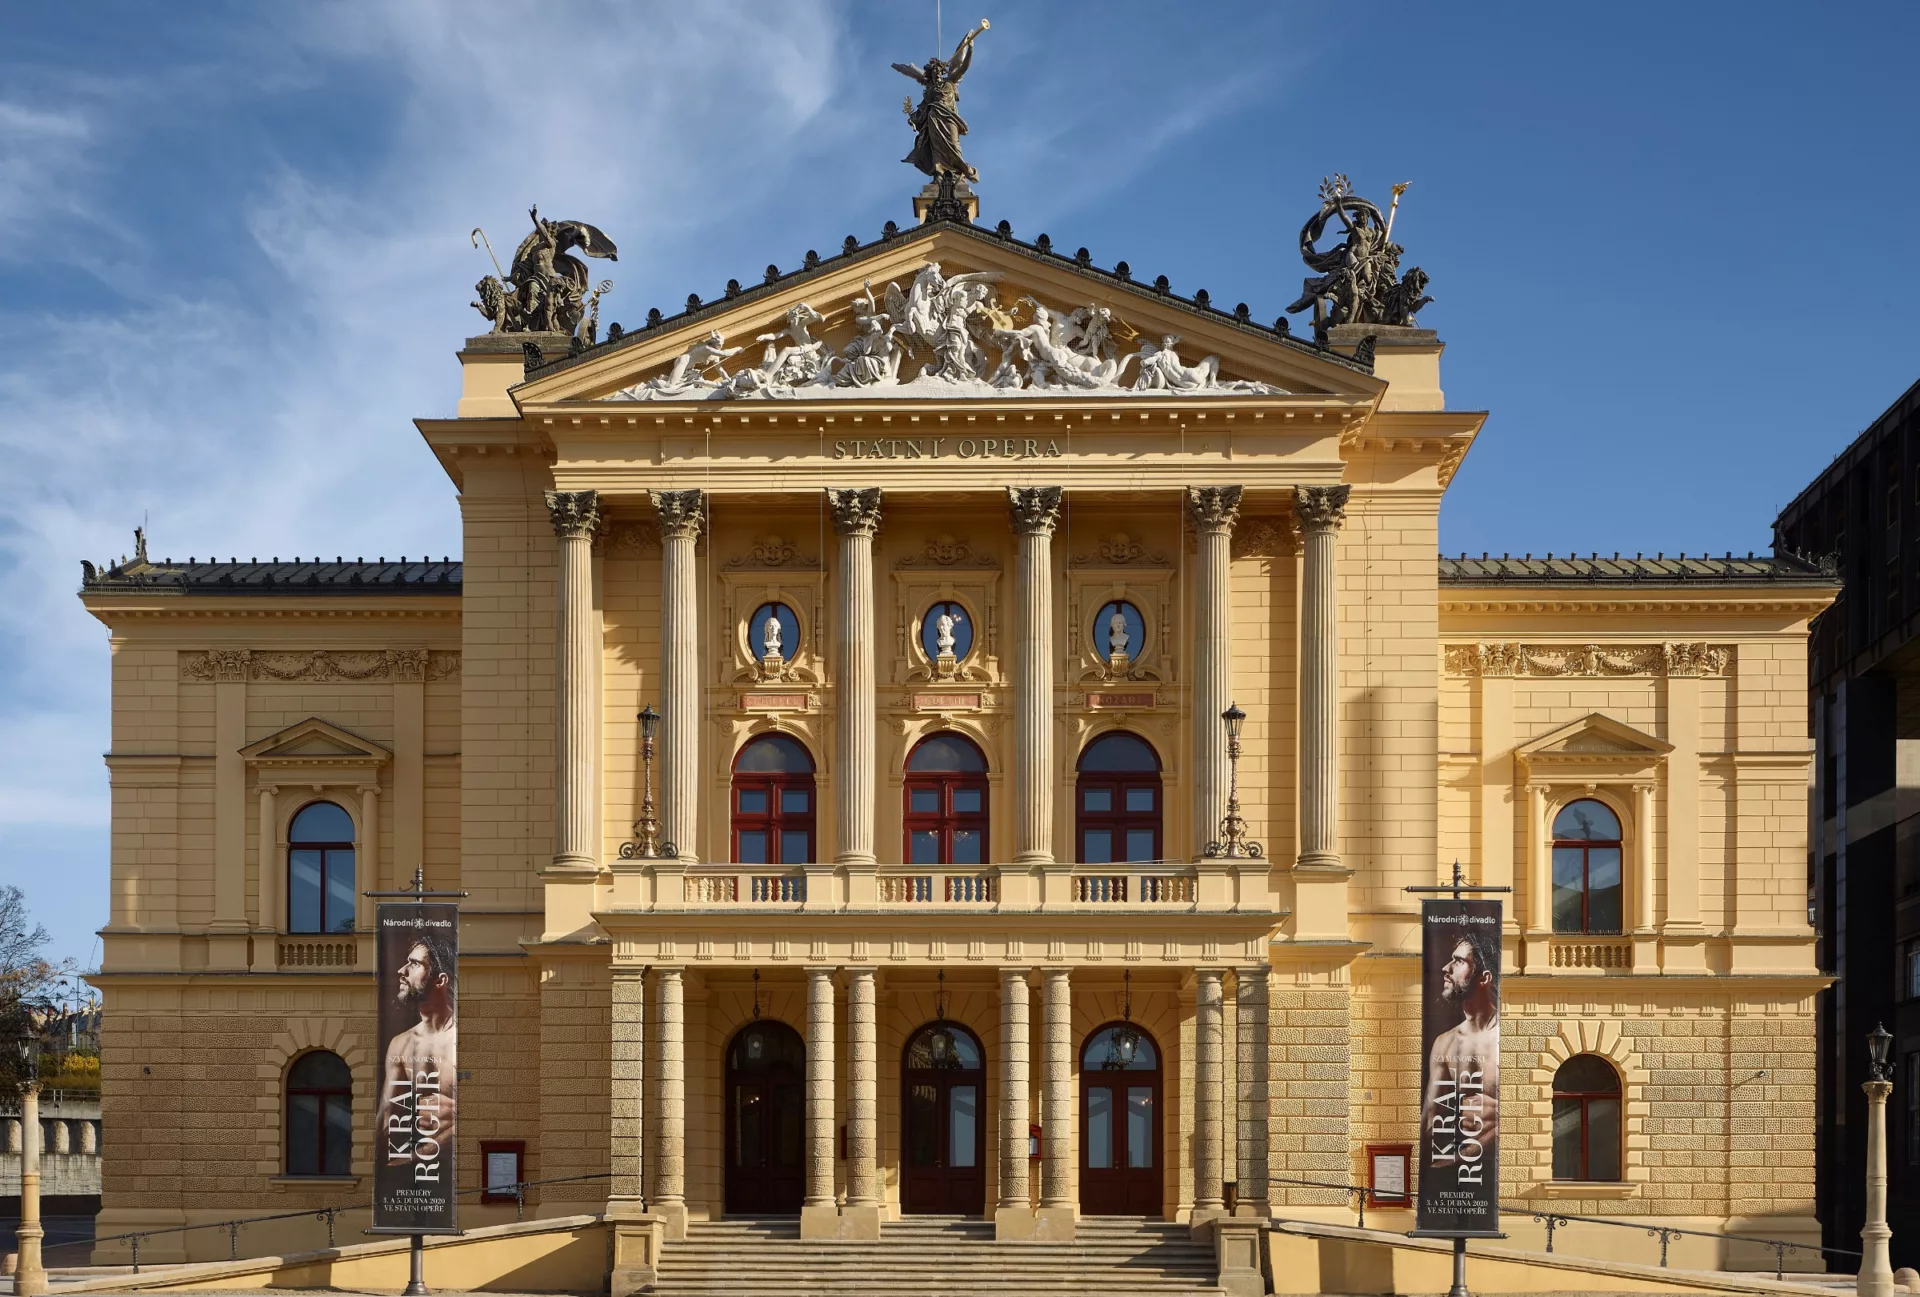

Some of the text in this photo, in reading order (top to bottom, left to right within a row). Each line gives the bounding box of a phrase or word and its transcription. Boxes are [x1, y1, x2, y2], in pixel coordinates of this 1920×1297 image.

[834, 437, 1062, 459] STÁTNÍ OPERA
[383, 918, 452, 927] Národní divadlo
[387, 1056, 443, 1064] SZYMANOWSKI
[1432, 1055, 1485, 1063] SZYMANOWSKI
[414, 1068, 440, 1184] ROGER
[1458, 1068, 1484, 1186] ROGER
[394, 1204, 420, 1212] STÁTNÍ
[1438, 1206, 1462, 1214] STÁTNÍ
